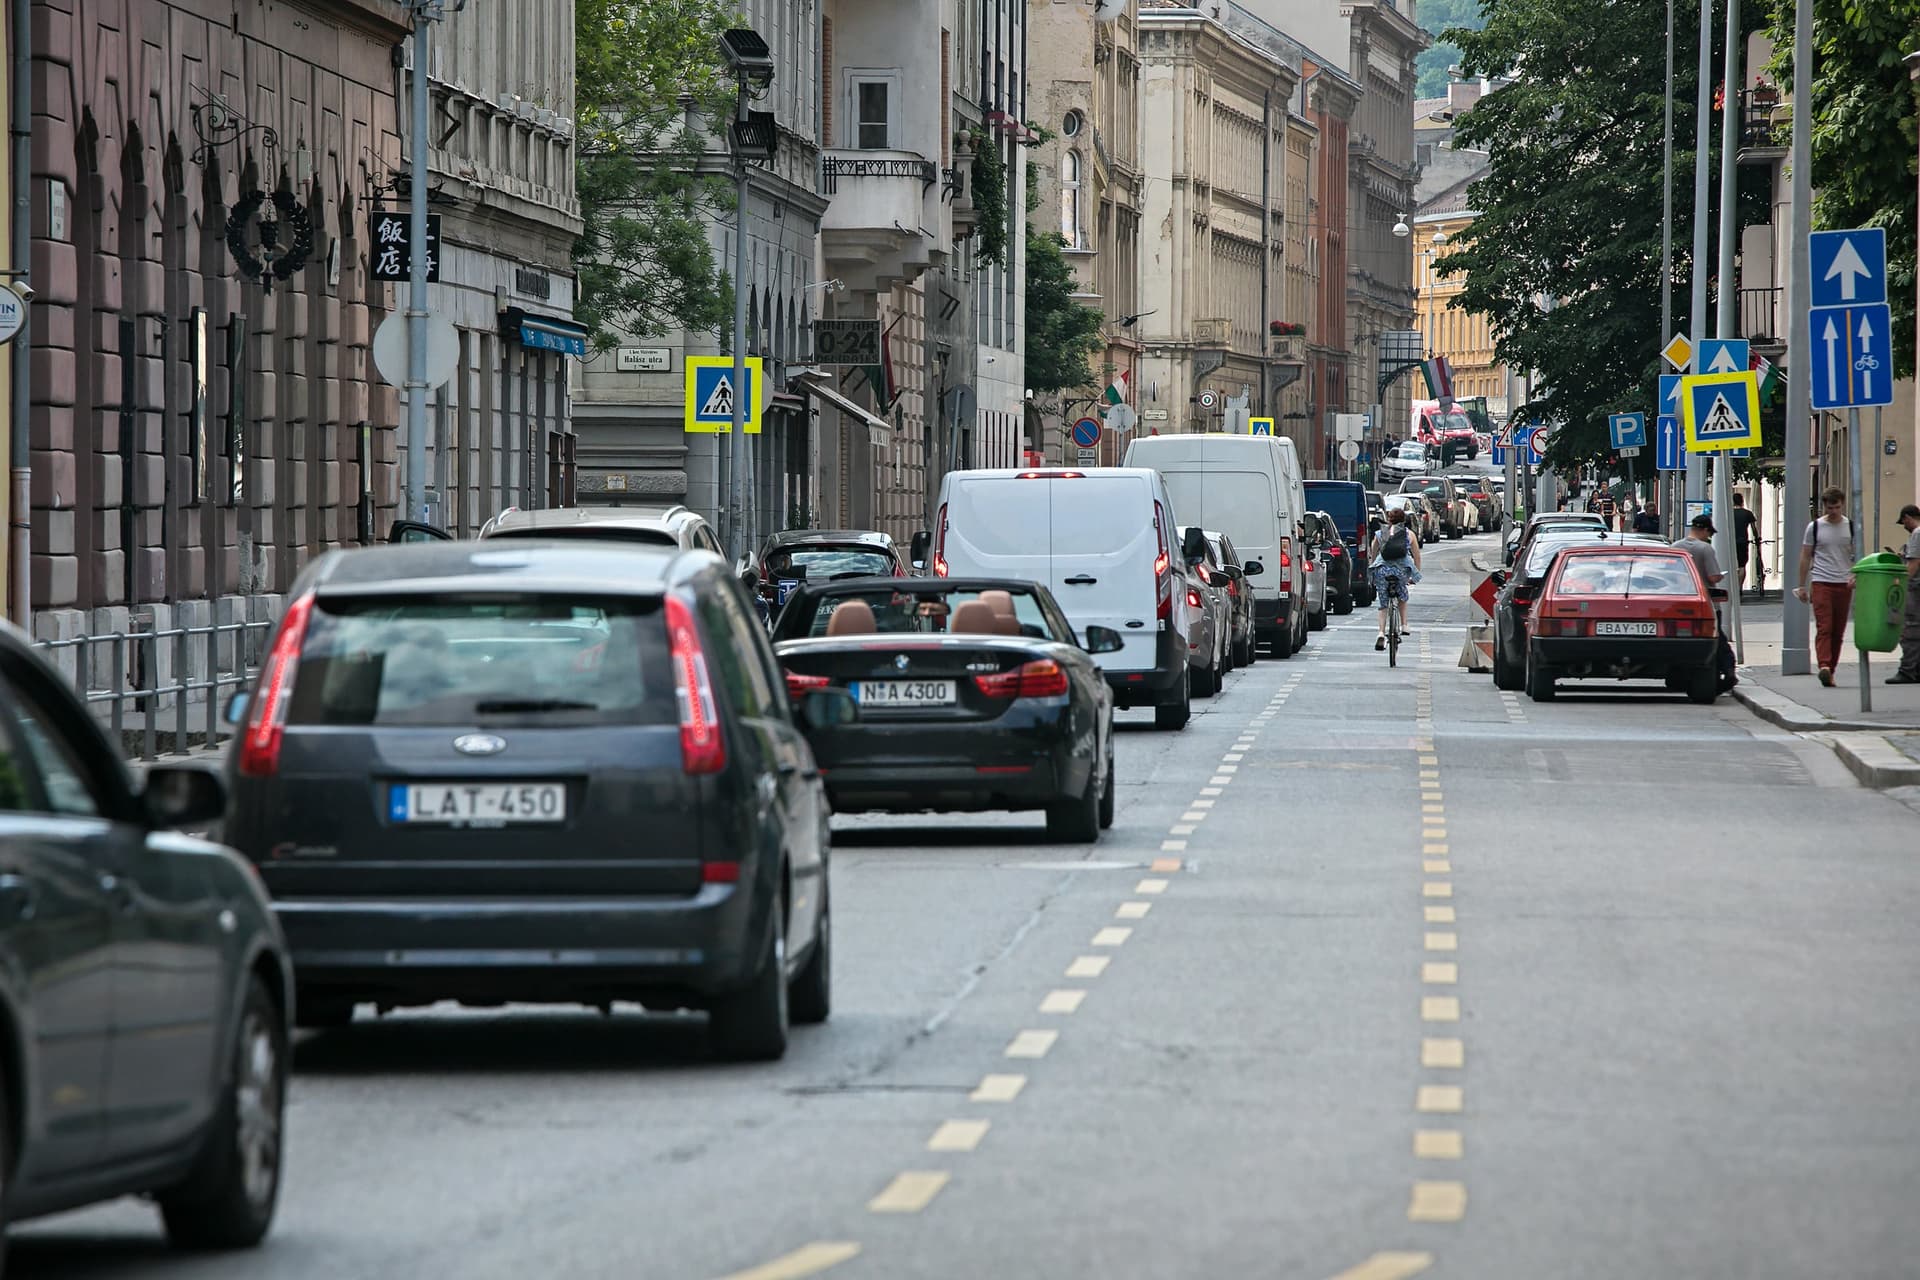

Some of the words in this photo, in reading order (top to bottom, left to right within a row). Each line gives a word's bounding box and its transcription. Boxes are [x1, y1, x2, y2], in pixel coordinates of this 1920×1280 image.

[376, 217, 408, 275] 飯店
[819, 331, 876, 354] 0-24
[624, 355, 645, 363] Halász
[1616, 417, 1637, 444] P
[1605, 623, 1656, 633] BAY-102
[965, 663, 1000, 671] 430i
[903, 682, 947, 700] 4300
[414, 787, 558, 816] LAT-450
